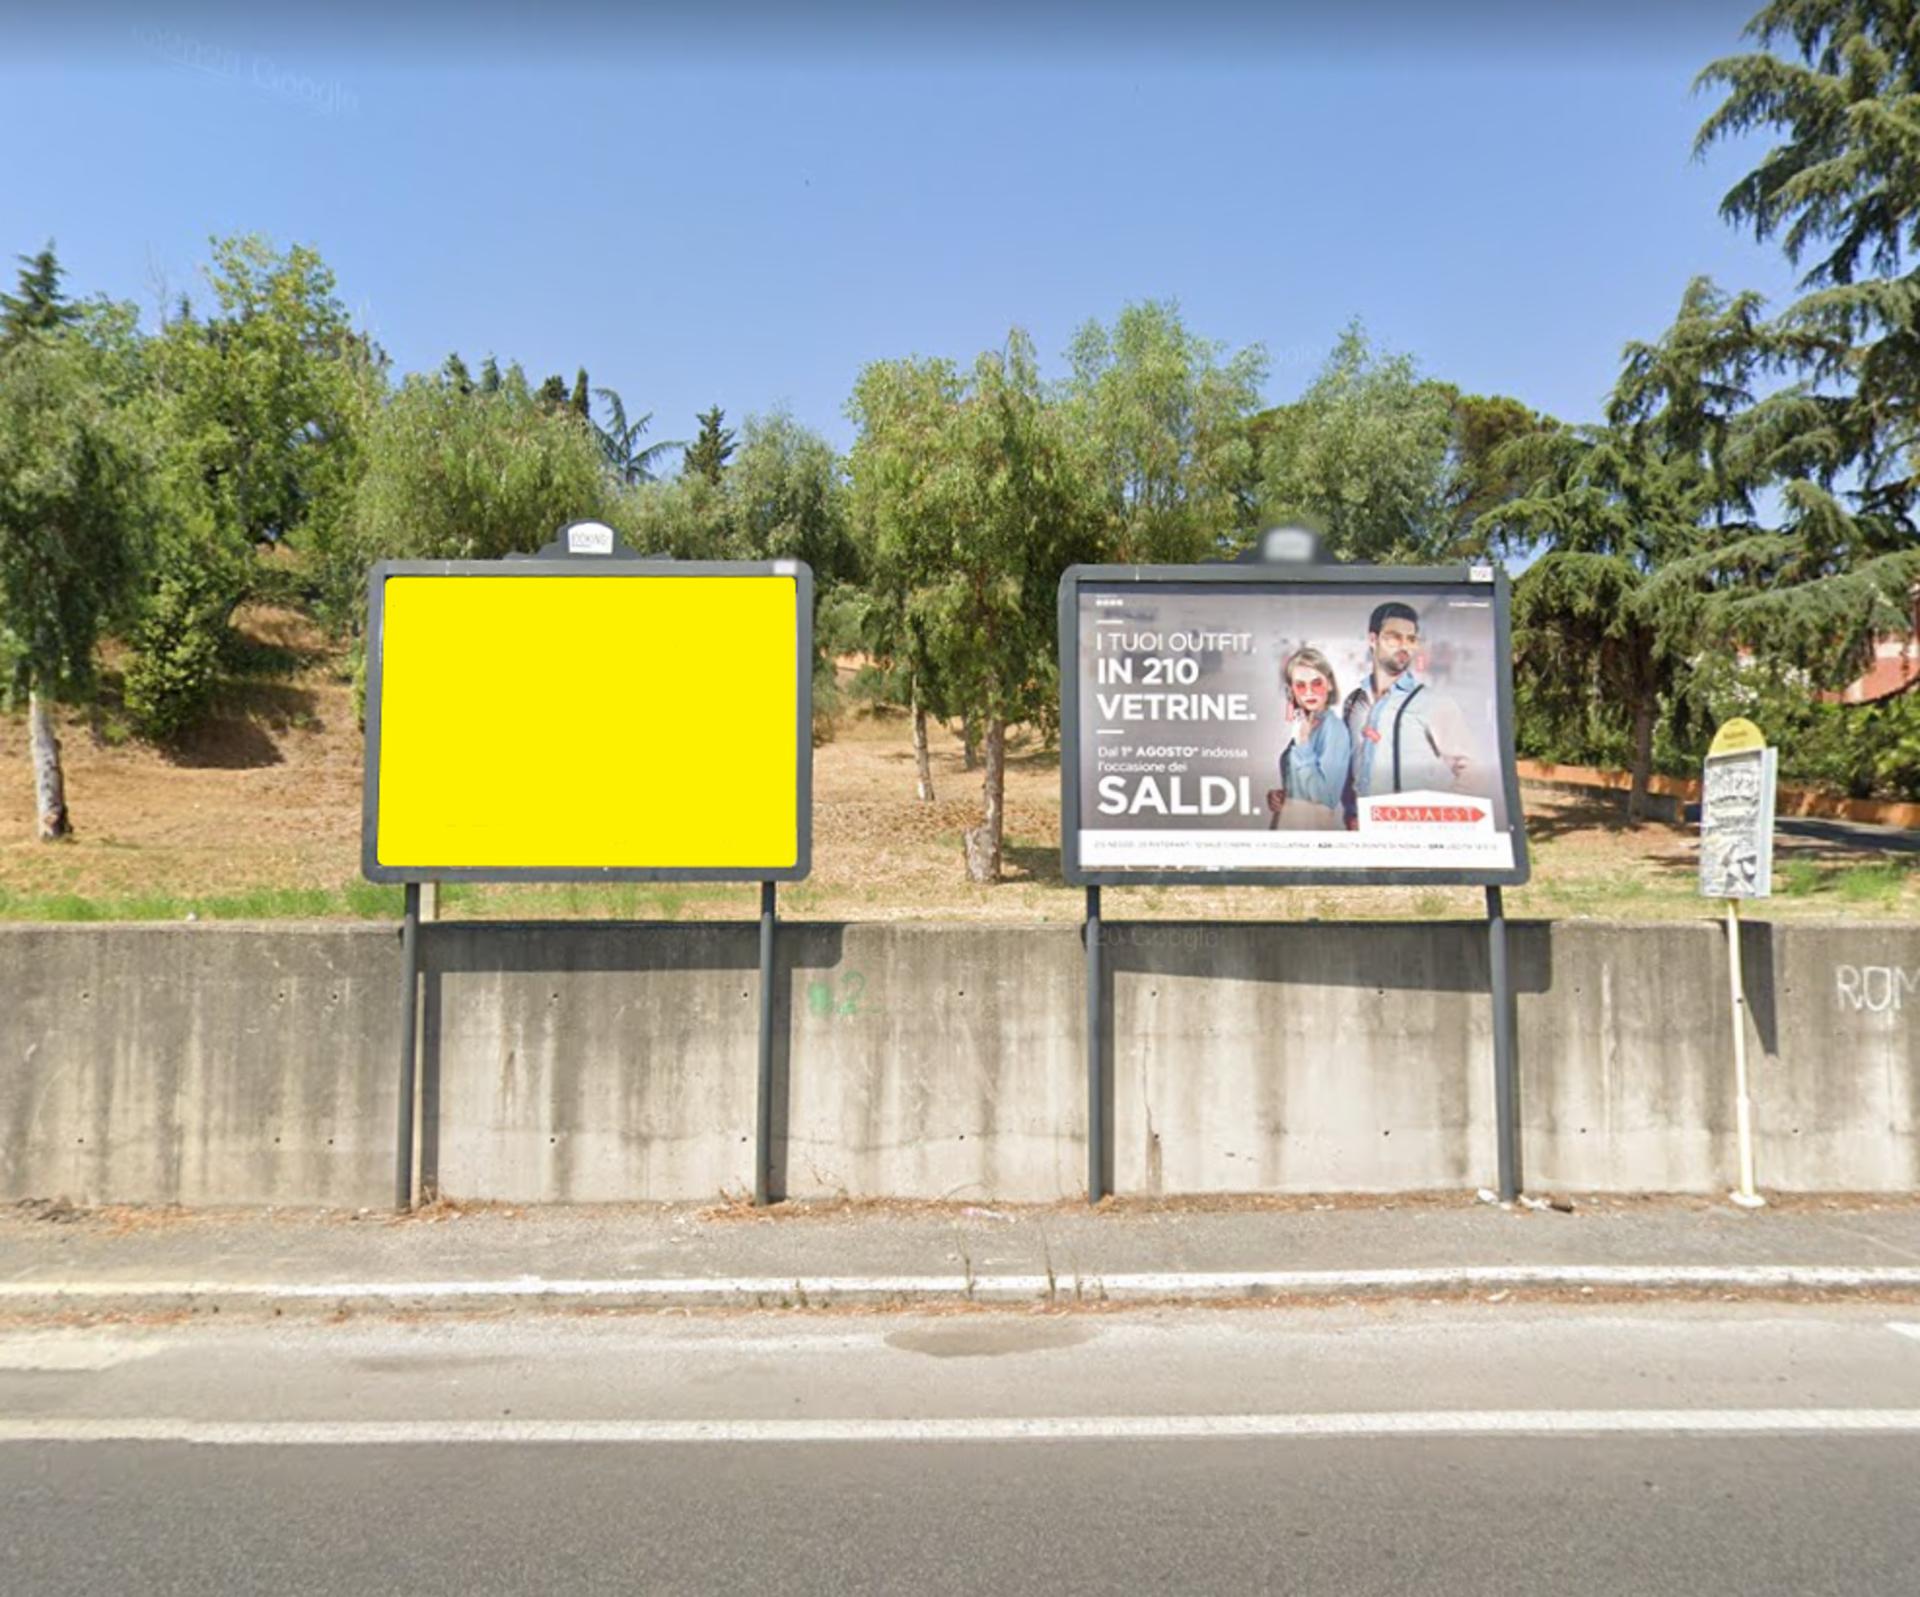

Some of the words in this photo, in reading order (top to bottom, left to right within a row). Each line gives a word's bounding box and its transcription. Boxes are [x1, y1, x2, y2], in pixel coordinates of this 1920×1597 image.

[1096, 633, 1102, 651] I
[1108, 633, 1164, 651] TUOI
[1168, 632, 1257, 654] OUTFIT,
[1098, 657, 1133, 685] IN
[1141, 657, 1200, 686] 210
[1096, 693, 1257, 721] VETRINE.
[1098, 746, 1118, 758] Dal
[1202, 746, 1248, 759] indossa
[1098, 760, 1166, 773] l'occasione
[1168, 761, 1188, 773] dei
[1097, 775, 1261, 815] SALDI.
